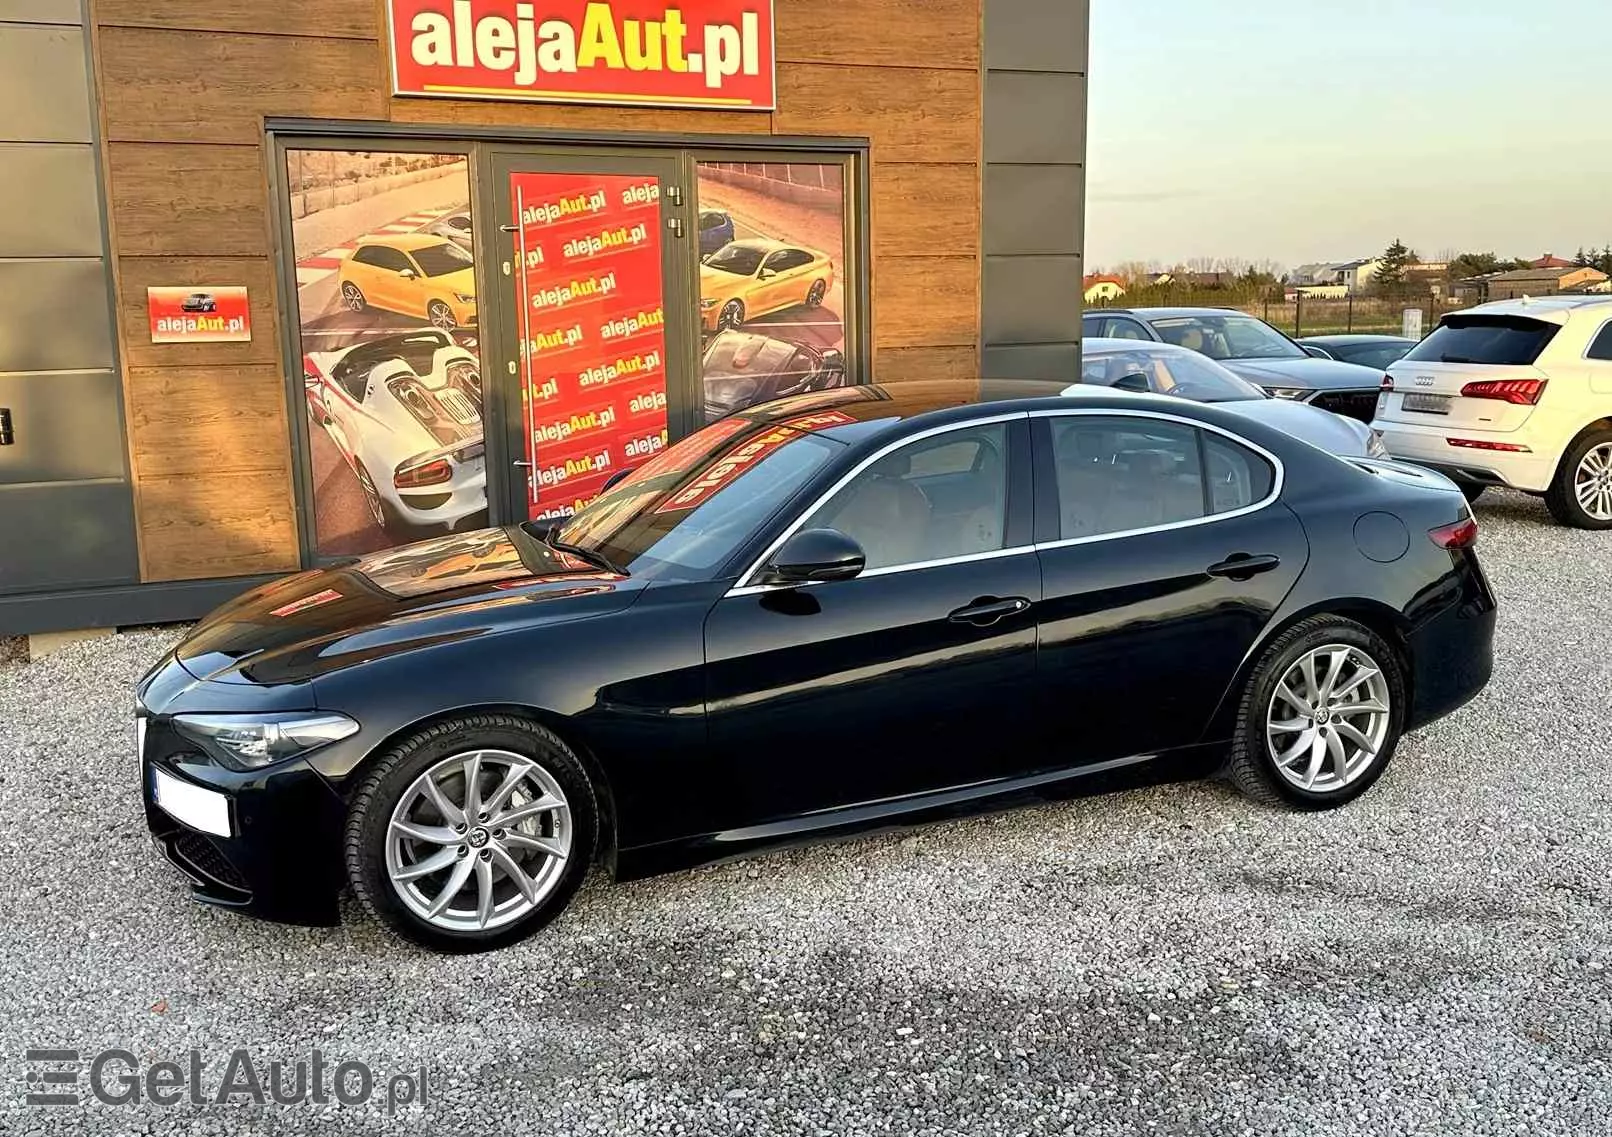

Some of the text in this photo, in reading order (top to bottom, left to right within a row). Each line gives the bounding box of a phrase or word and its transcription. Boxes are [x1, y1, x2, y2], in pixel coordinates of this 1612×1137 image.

[411, 0, 760, 88] alejaAut.pl
[523, 190, 606, 224] alejaAut.pl
[563, 223, 647, 258] alejaAut.pl
[532, 273, 616, 308] alejaAut.pl
[157, 315, 245, 334] alejaAut.pl
[579, 350, 660, 386] alejaAut.pl
[534, 407, 615, 443] alejaAut.pl
